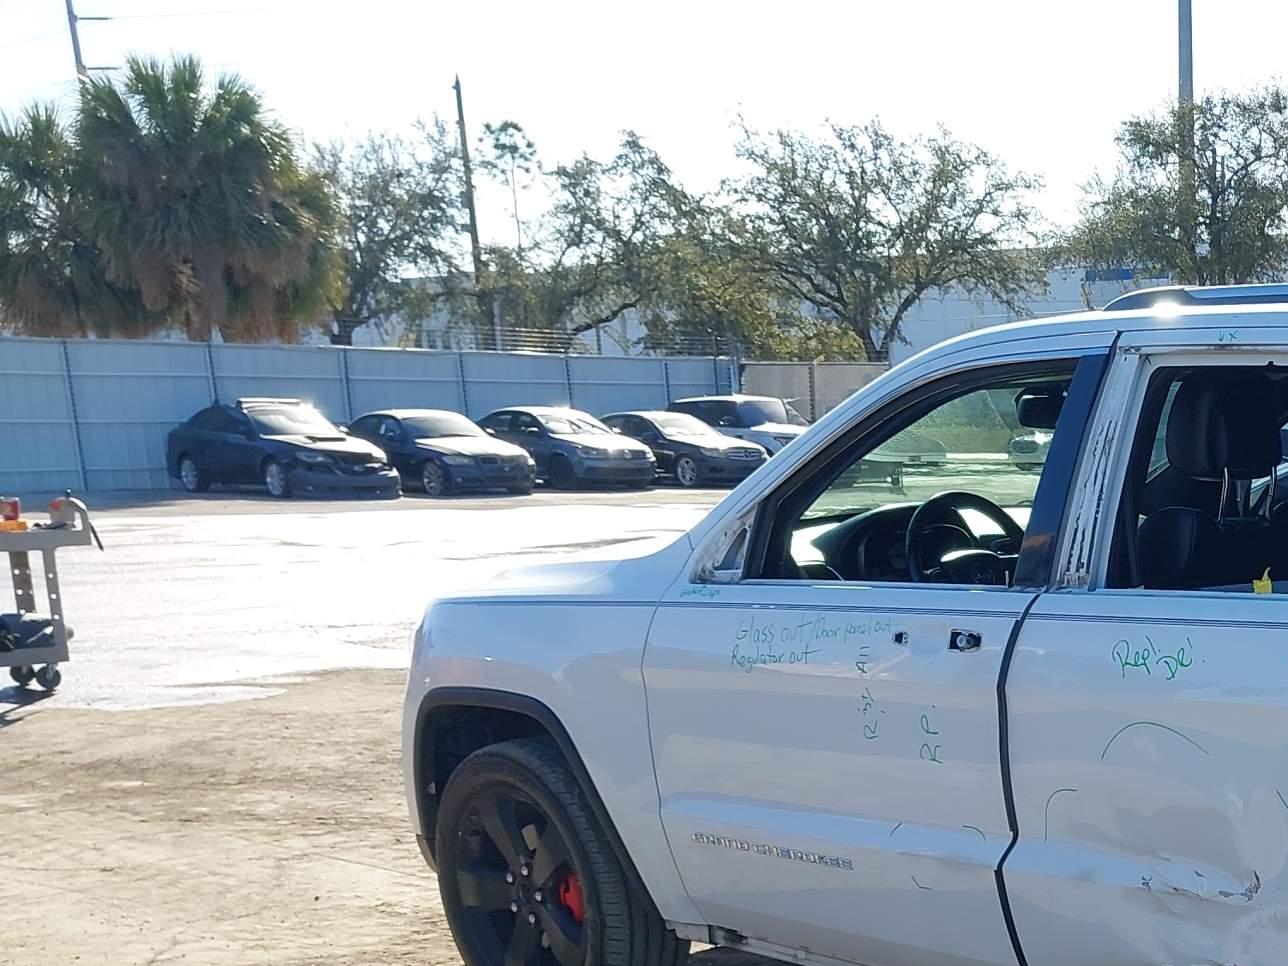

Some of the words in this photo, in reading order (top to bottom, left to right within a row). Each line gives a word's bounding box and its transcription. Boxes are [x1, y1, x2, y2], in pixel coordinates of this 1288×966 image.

[736, 614, 774, 643] Glass
[730, 643, 785, 673] Regulator
[789, 643, 822, 665] out
